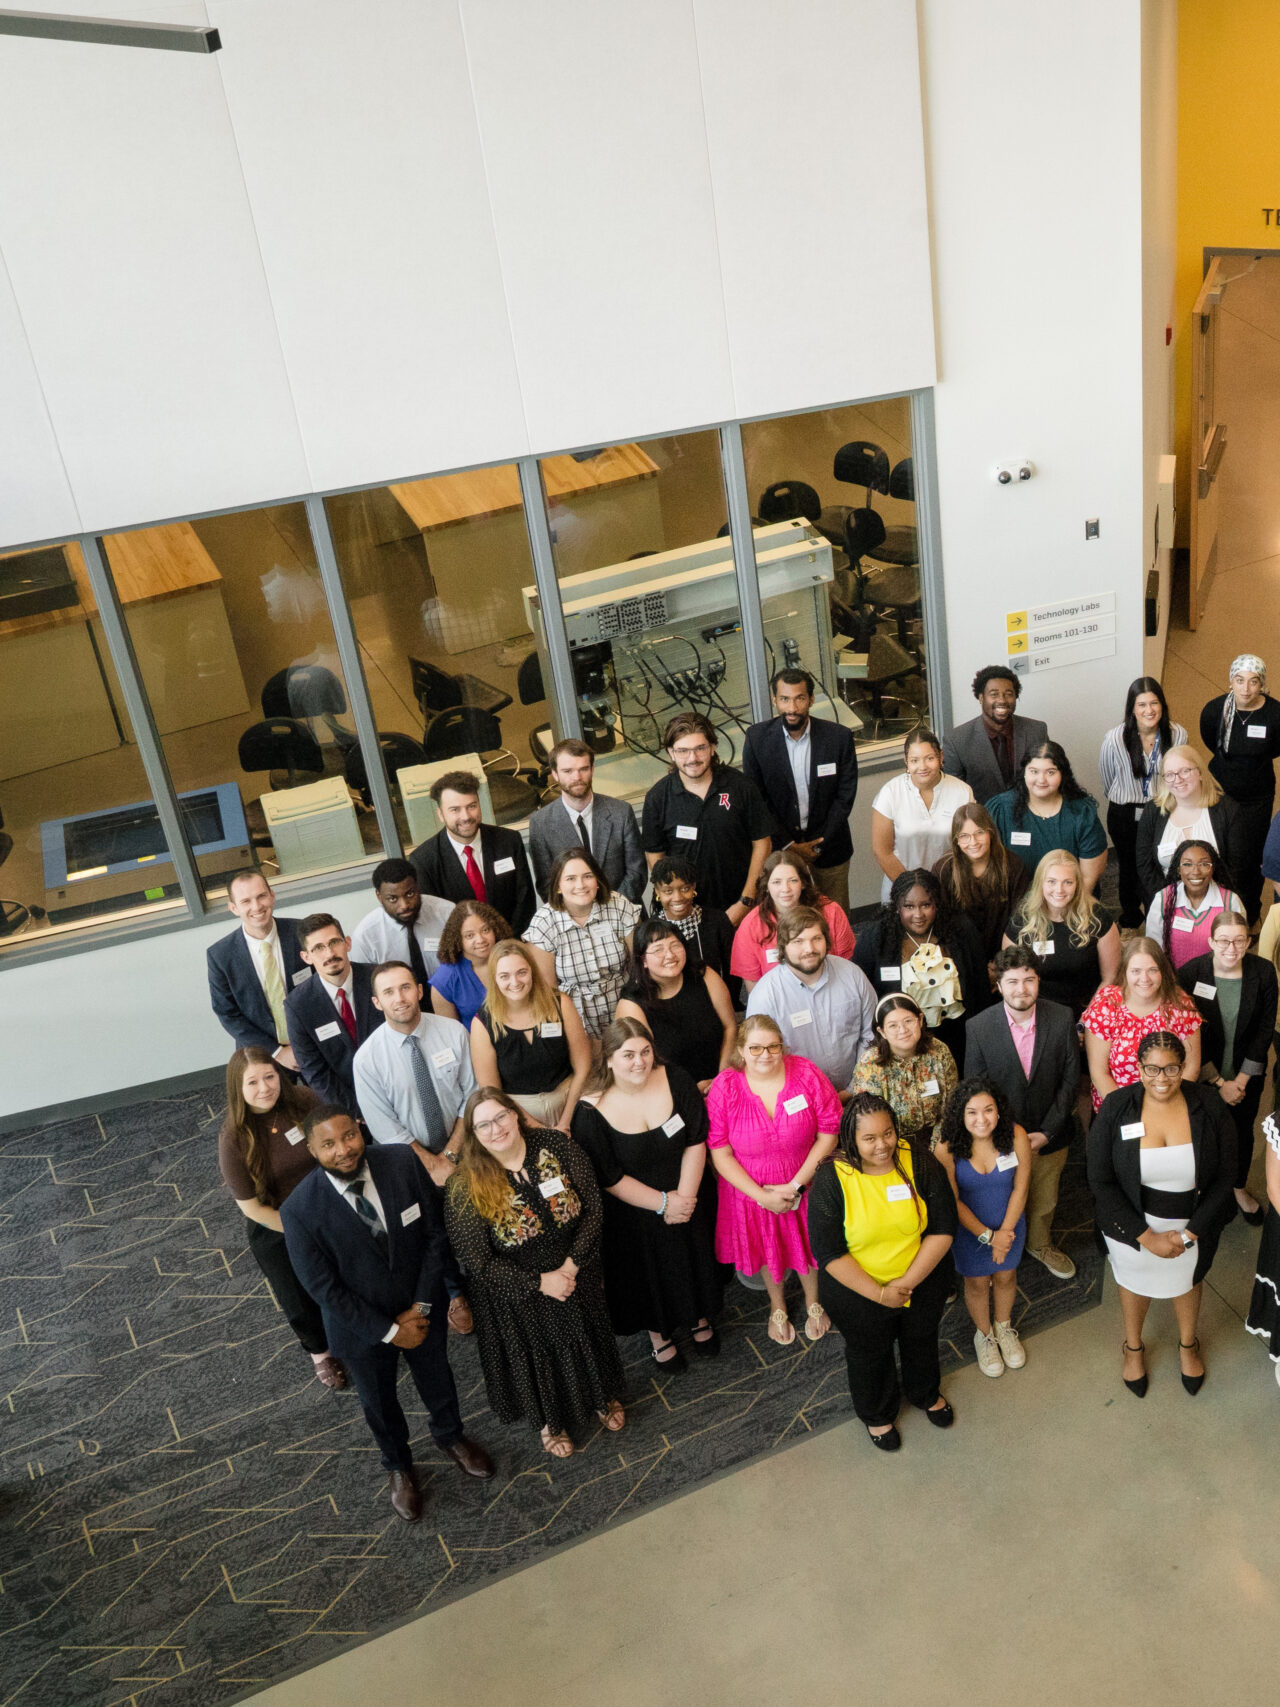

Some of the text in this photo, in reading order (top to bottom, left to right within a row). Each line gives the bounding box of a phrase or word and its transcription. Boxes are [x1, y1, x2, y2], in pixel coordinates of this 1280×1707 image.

[1033, 602, 1100, 621] Technology Labs
[1034, 624, 1098, 644] Rooms 101-130
[1034, 657, 1050, 667] Exit
[719, 793, 730, 810] R
